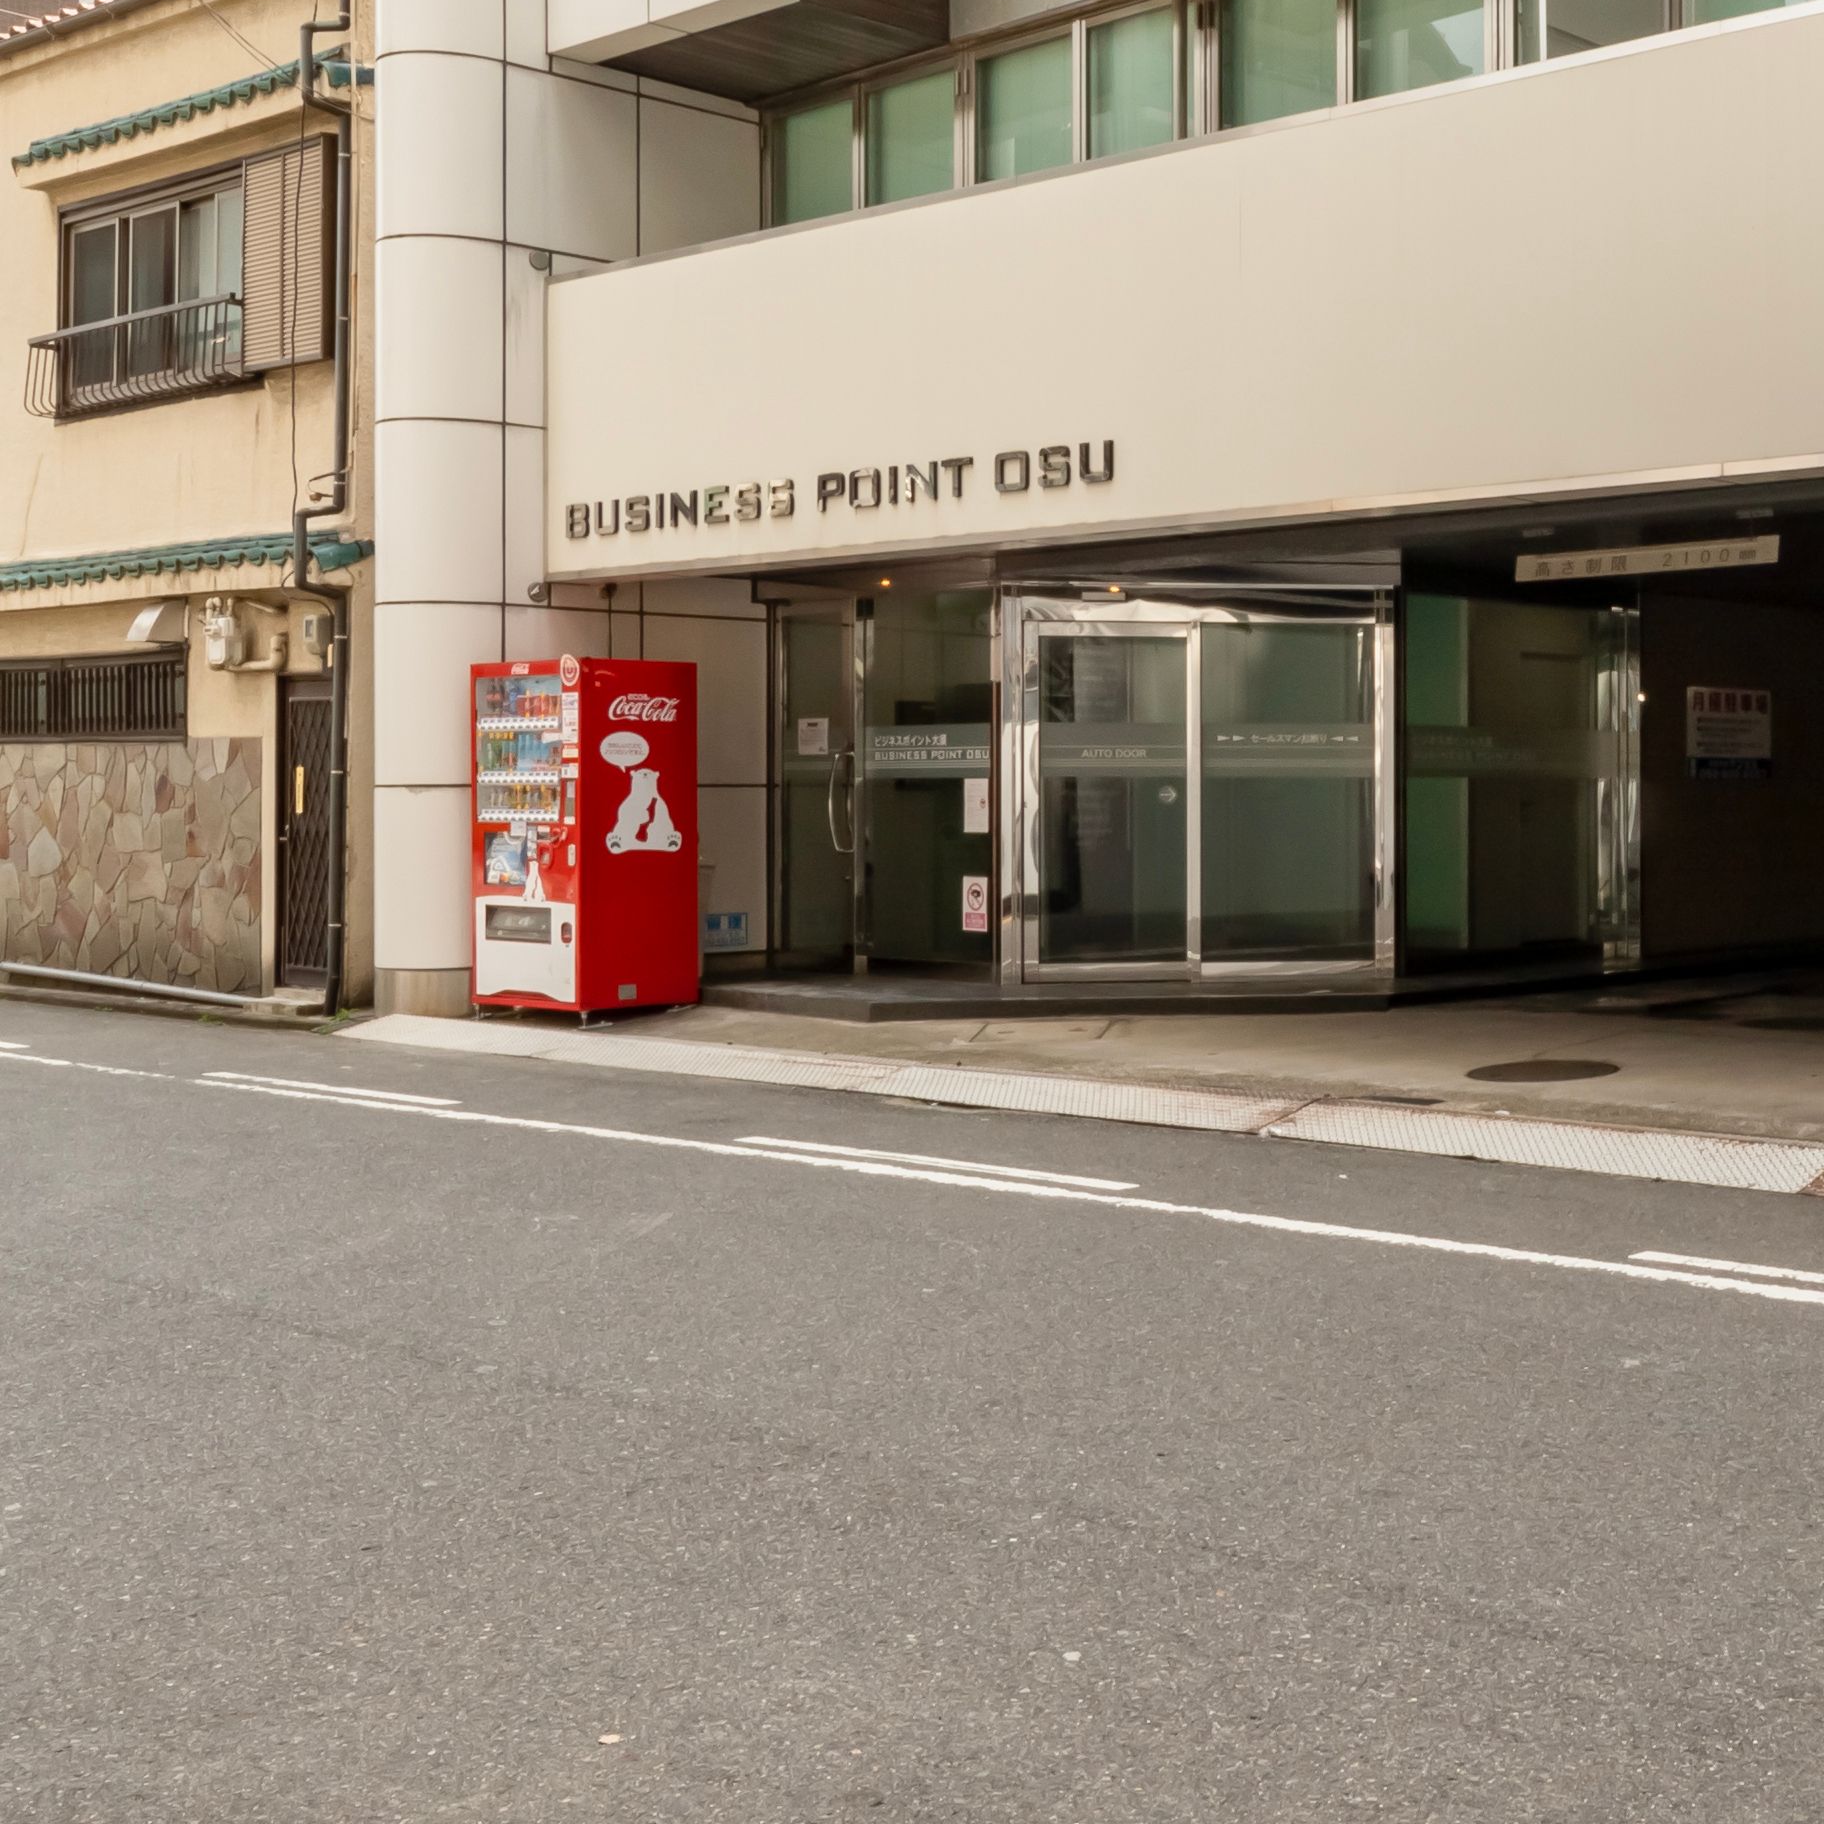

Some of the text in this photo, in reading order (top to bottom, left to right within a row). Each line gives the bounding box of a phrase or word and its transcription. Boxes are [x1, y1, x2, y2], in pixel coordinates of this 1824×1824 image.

[565, 439, 1115, 539] BUSINESS POINT OSU
[1534, 555, 1628, 578] 高さ制限
[874, 750, 928, 761] BUSINESS
[930, 749, 963, 760] POINT
[1081, 748, 1147, 758] AUTO DOOR
